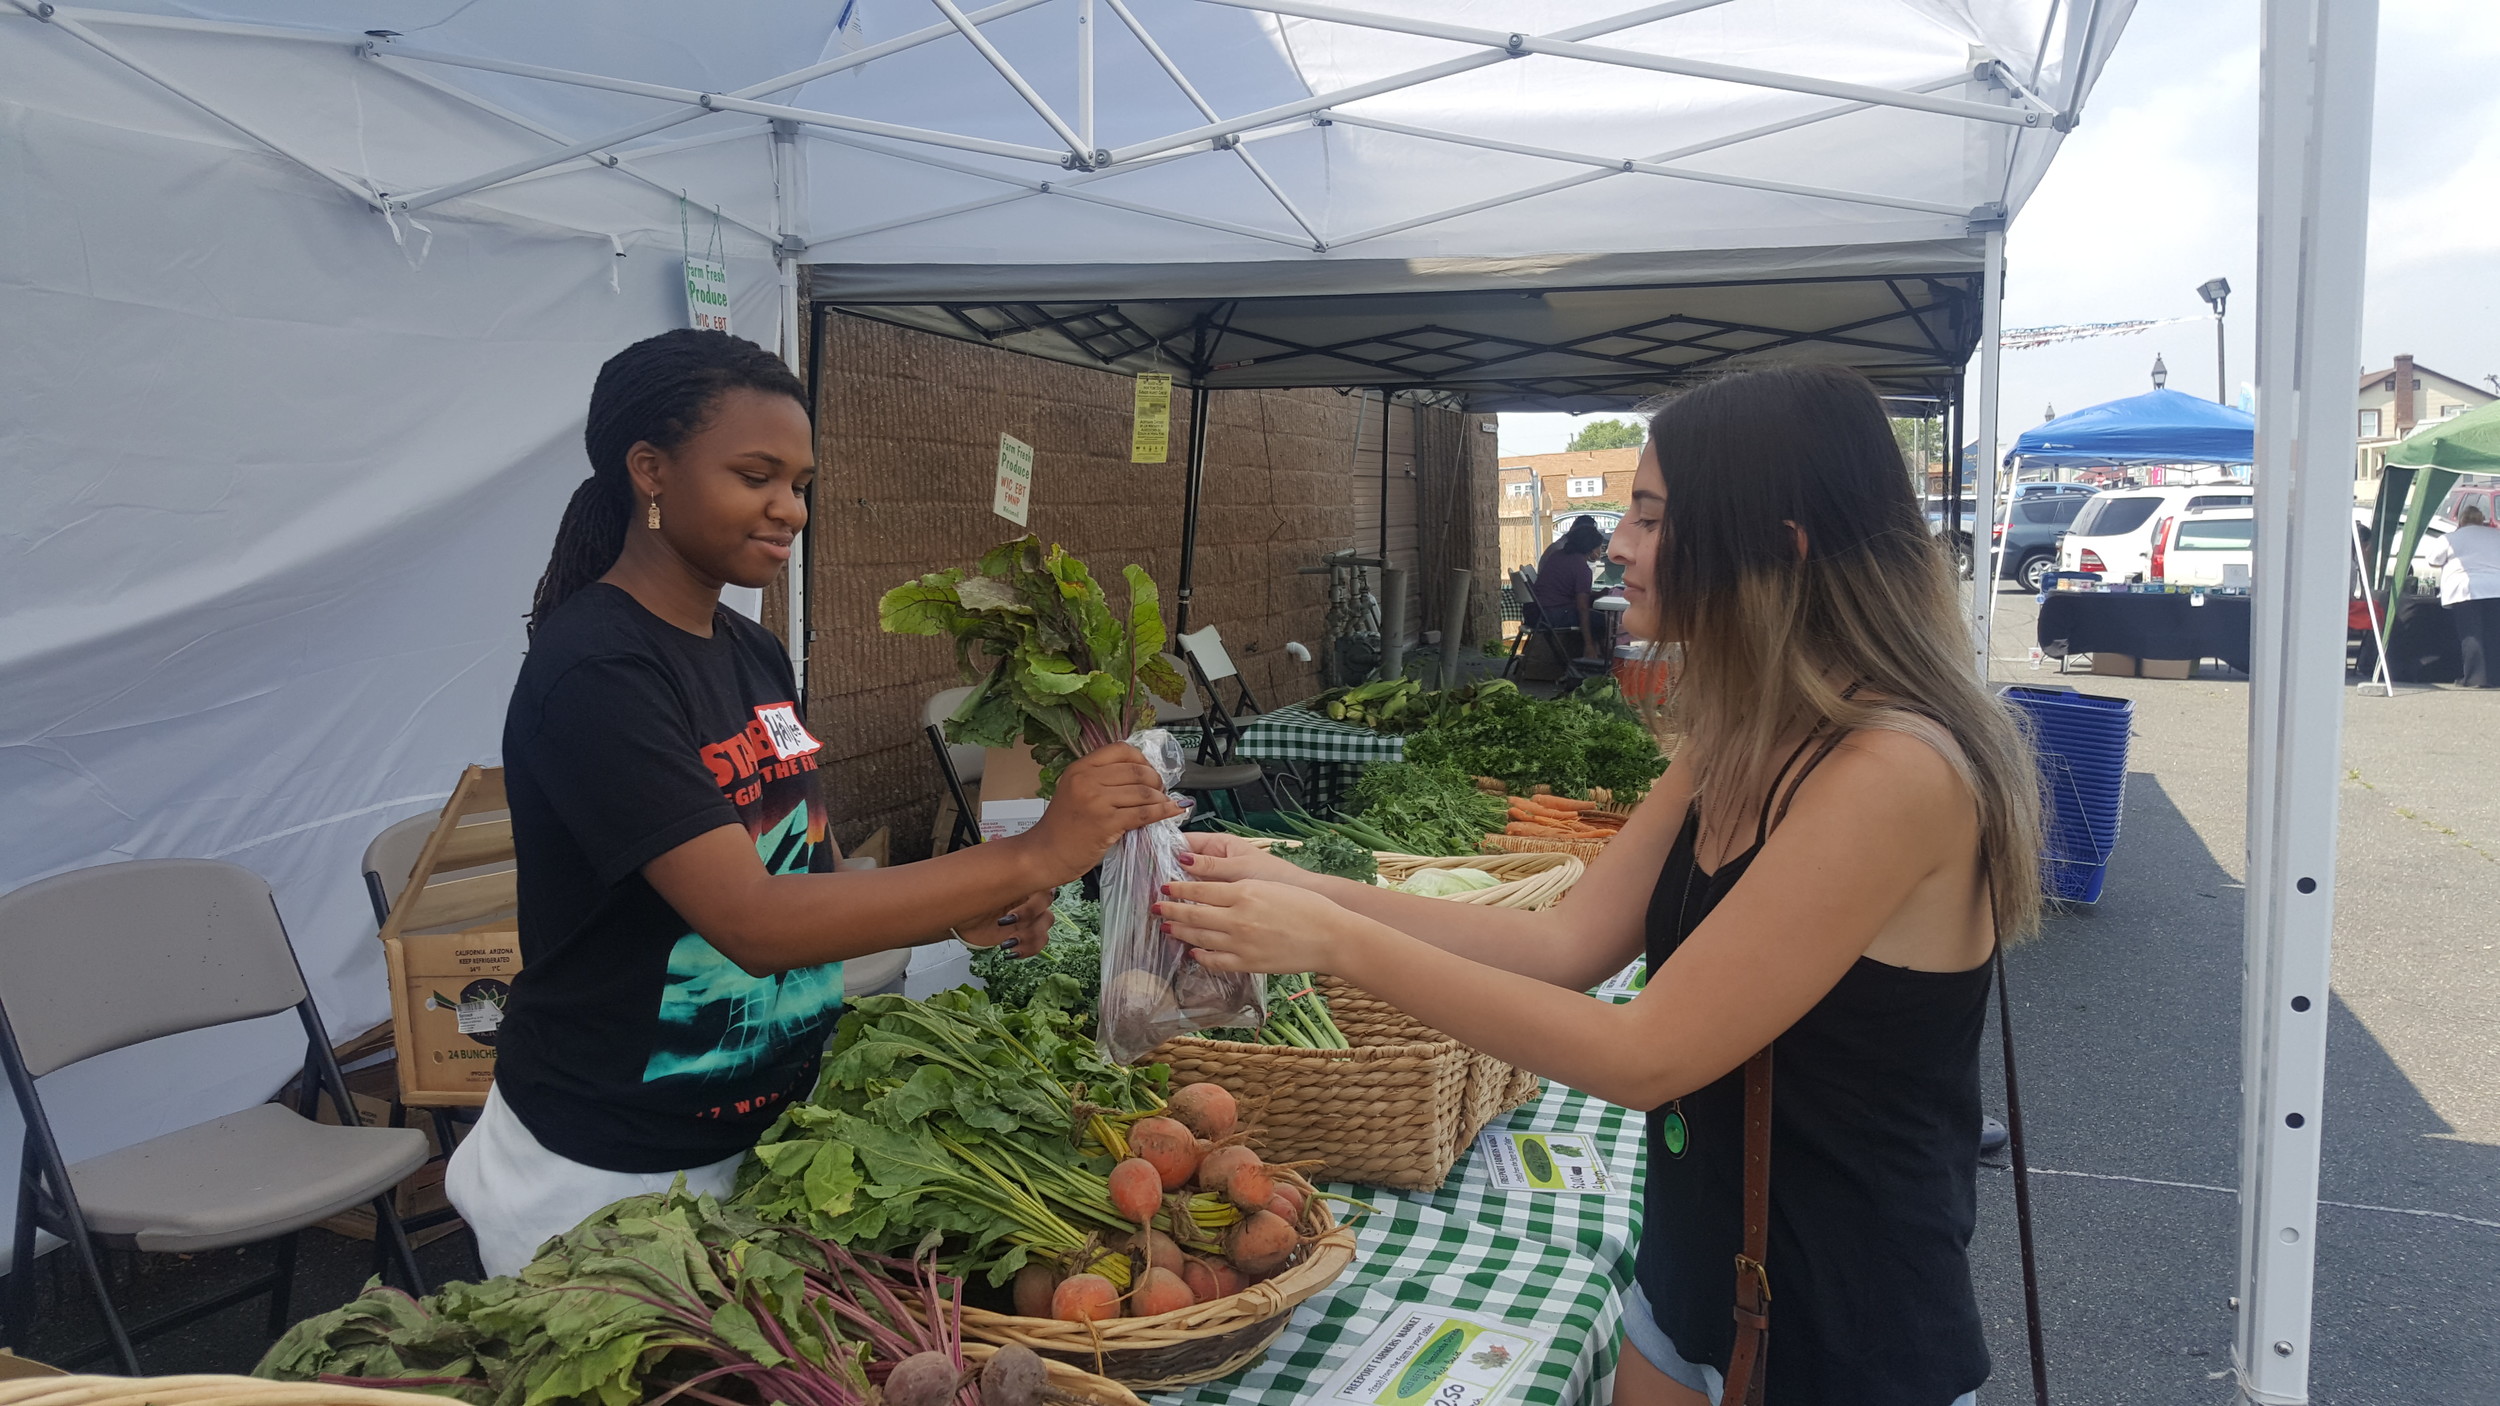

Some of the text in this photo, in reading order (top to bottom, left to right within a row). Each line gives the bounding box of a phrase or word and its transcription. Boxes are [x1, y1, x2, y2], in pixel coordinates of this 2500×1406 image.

[686, 261, 726, 283] Farm Fresh
[688, 280, 728, 307] Produce
[695, 312, 727, 330] WIC EBT
[1002, 438, 1032, 463] Farm Fresh
[1001, 452, 1030, 479] Produce
[1000, 476, 1027, 497] WIC EBT
[760, 759, 800, 783] THE
[800, 755, 818, 772] FA
[447, 1049, 497, 1059] 24 BUNCHE
[1343, 1316, 1421, 1394] FREEPORT FARMERS MARKET
[1379, 1369, 1391, 1381] from
[1390, 1358, 1400, 1369] the
[1396, 1350, 1412, 1362] Farm
[1413, 1335, 1423, 1347] your
